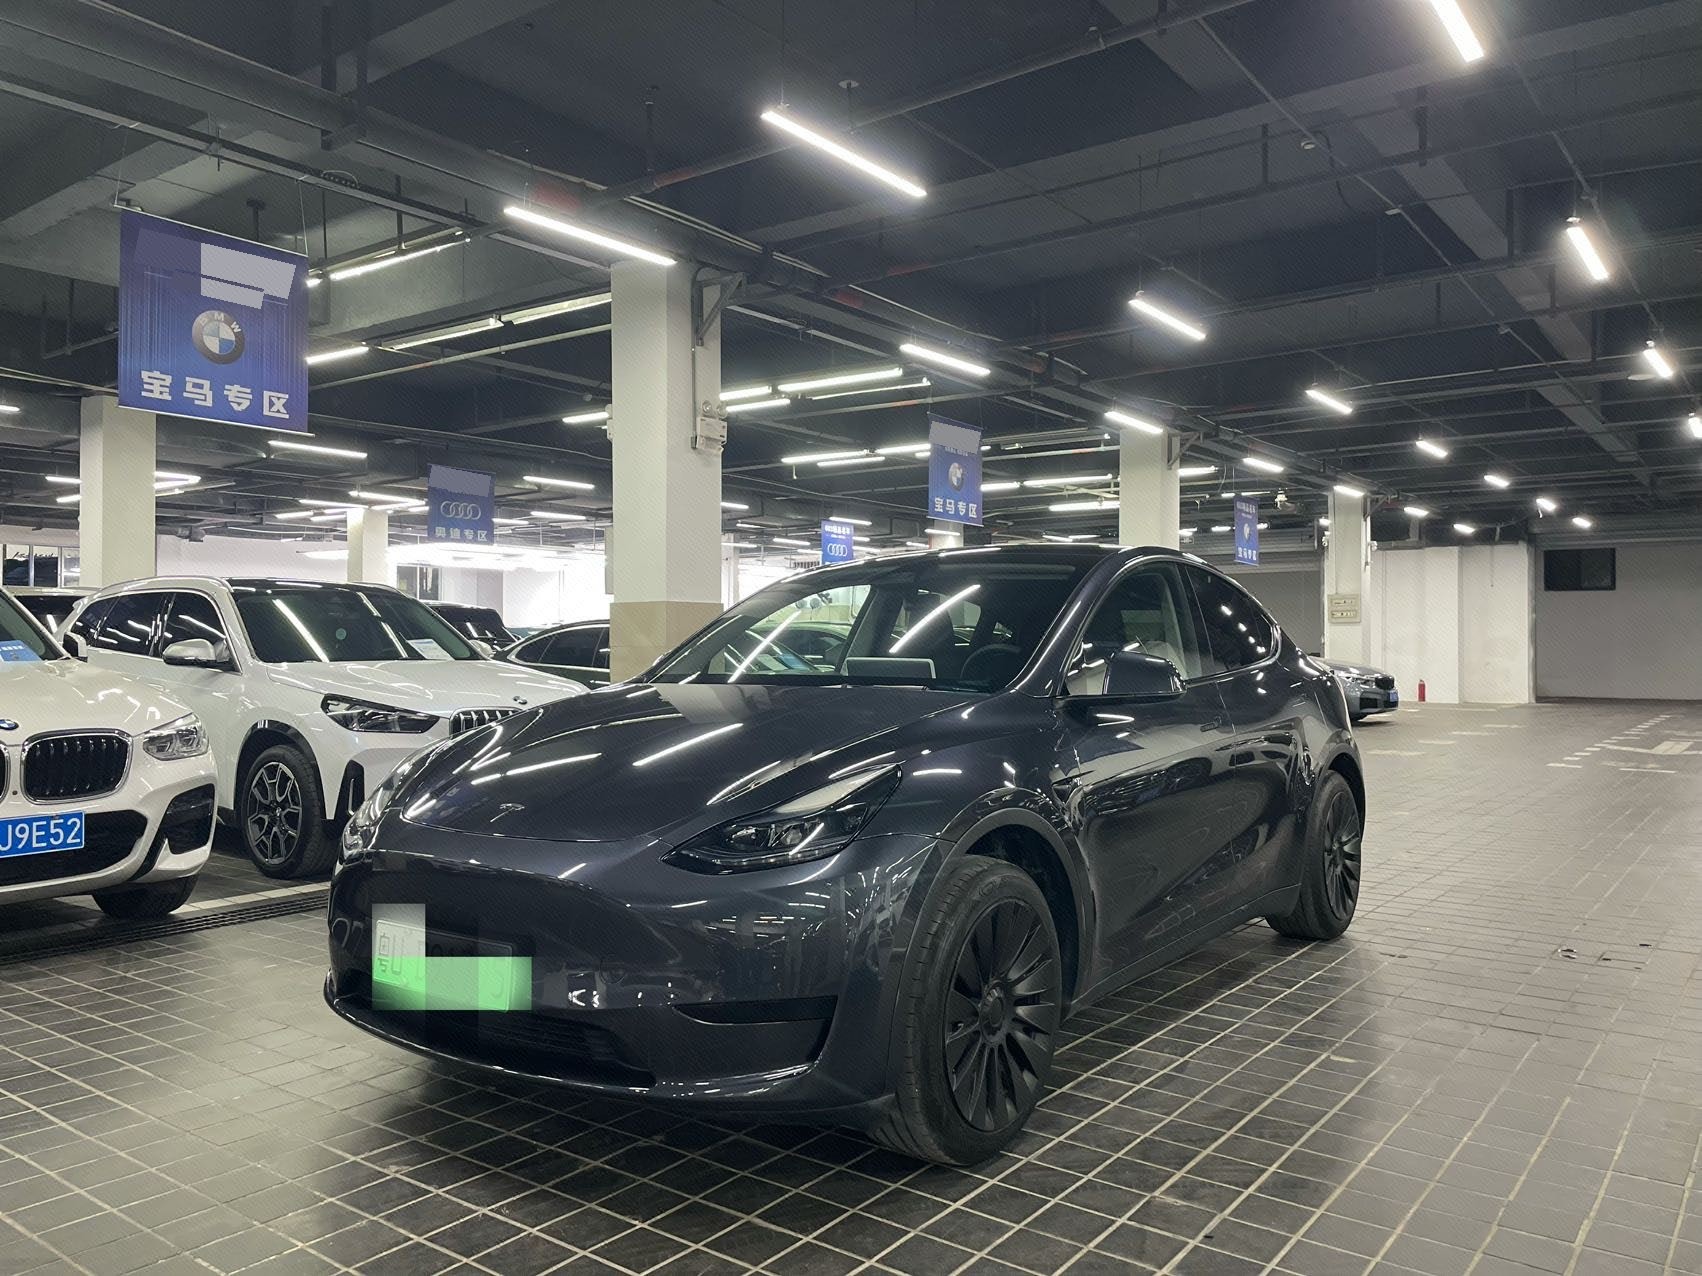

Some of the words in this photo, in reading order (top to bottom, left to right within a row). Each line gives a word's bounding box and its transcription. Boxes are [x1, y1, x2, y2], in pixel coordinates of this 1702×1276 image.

[141, 370, 290, 419] 宝马专区
[934, 496, 978, 518] 宝马专区
[0, 817, 81, 851] J9E52
